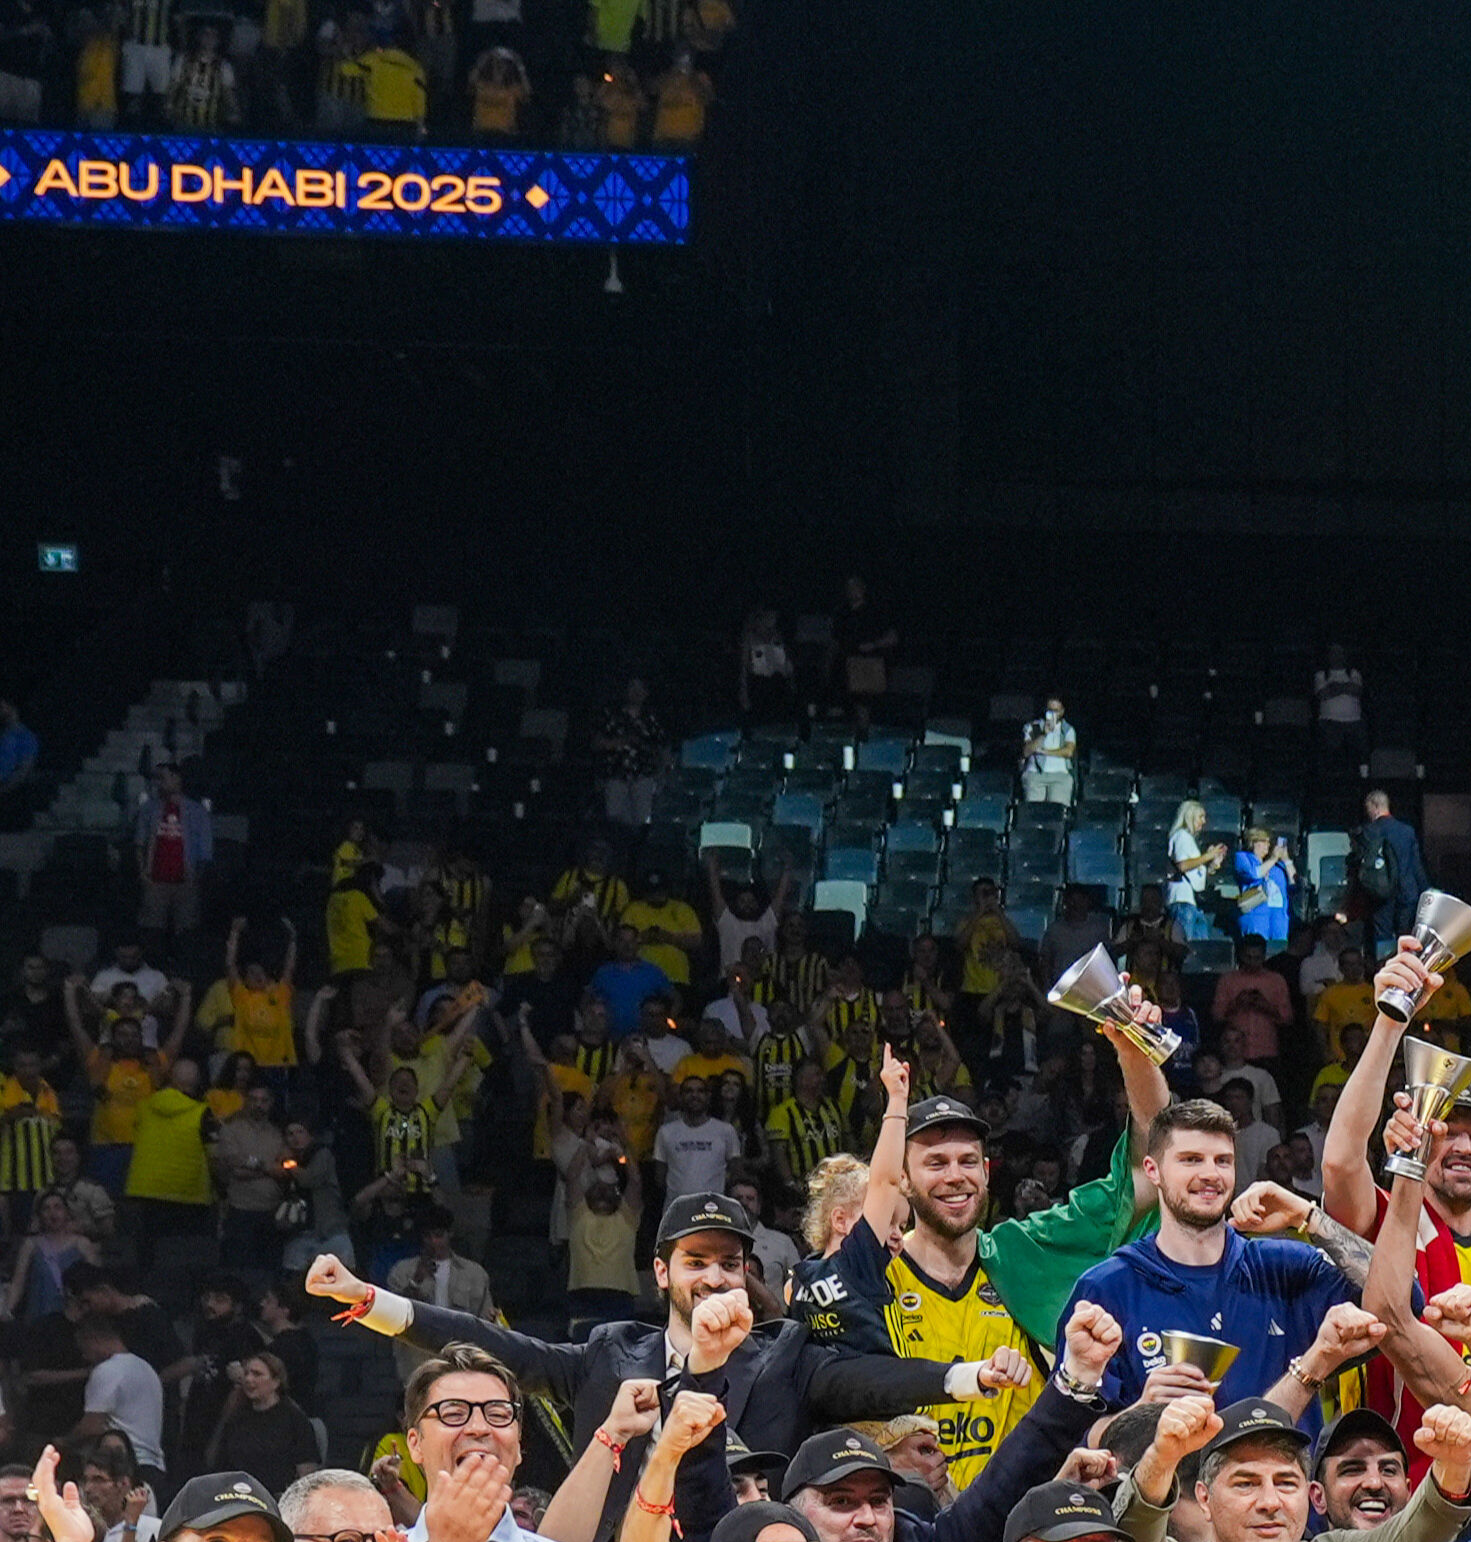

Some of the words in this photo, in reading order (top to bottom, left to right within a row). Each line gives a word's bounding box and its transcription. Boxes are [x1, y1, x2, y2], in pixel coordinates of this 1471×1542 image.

[35, 158, 160, 202] ABU
[171, 164, 346, 209] DHABI
[356, 172, 503, 215] 2025
[1055, 1505, 1102, 1516] CHAMPIONS
